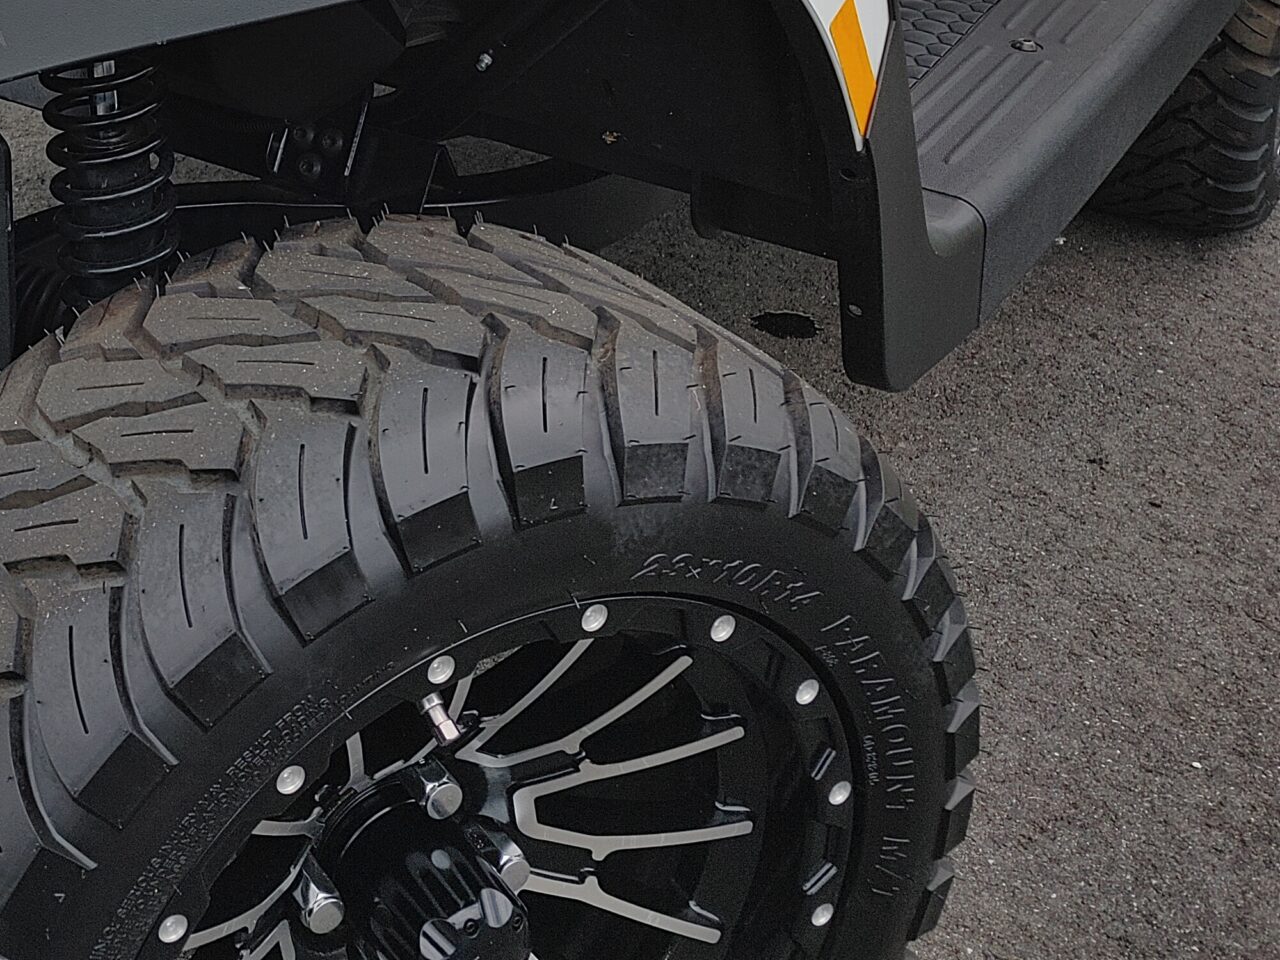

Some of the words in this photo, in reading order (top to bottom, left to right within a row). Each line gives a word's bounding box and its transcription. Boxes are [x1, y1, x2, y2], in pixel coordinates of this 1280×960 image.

[225, 728, 276, 778] RESULT
[274, 693, 316, 731] FROM
[273, 695, 330, 746] LOADING
[820, 615, 915, 810] PARAMOUNT
